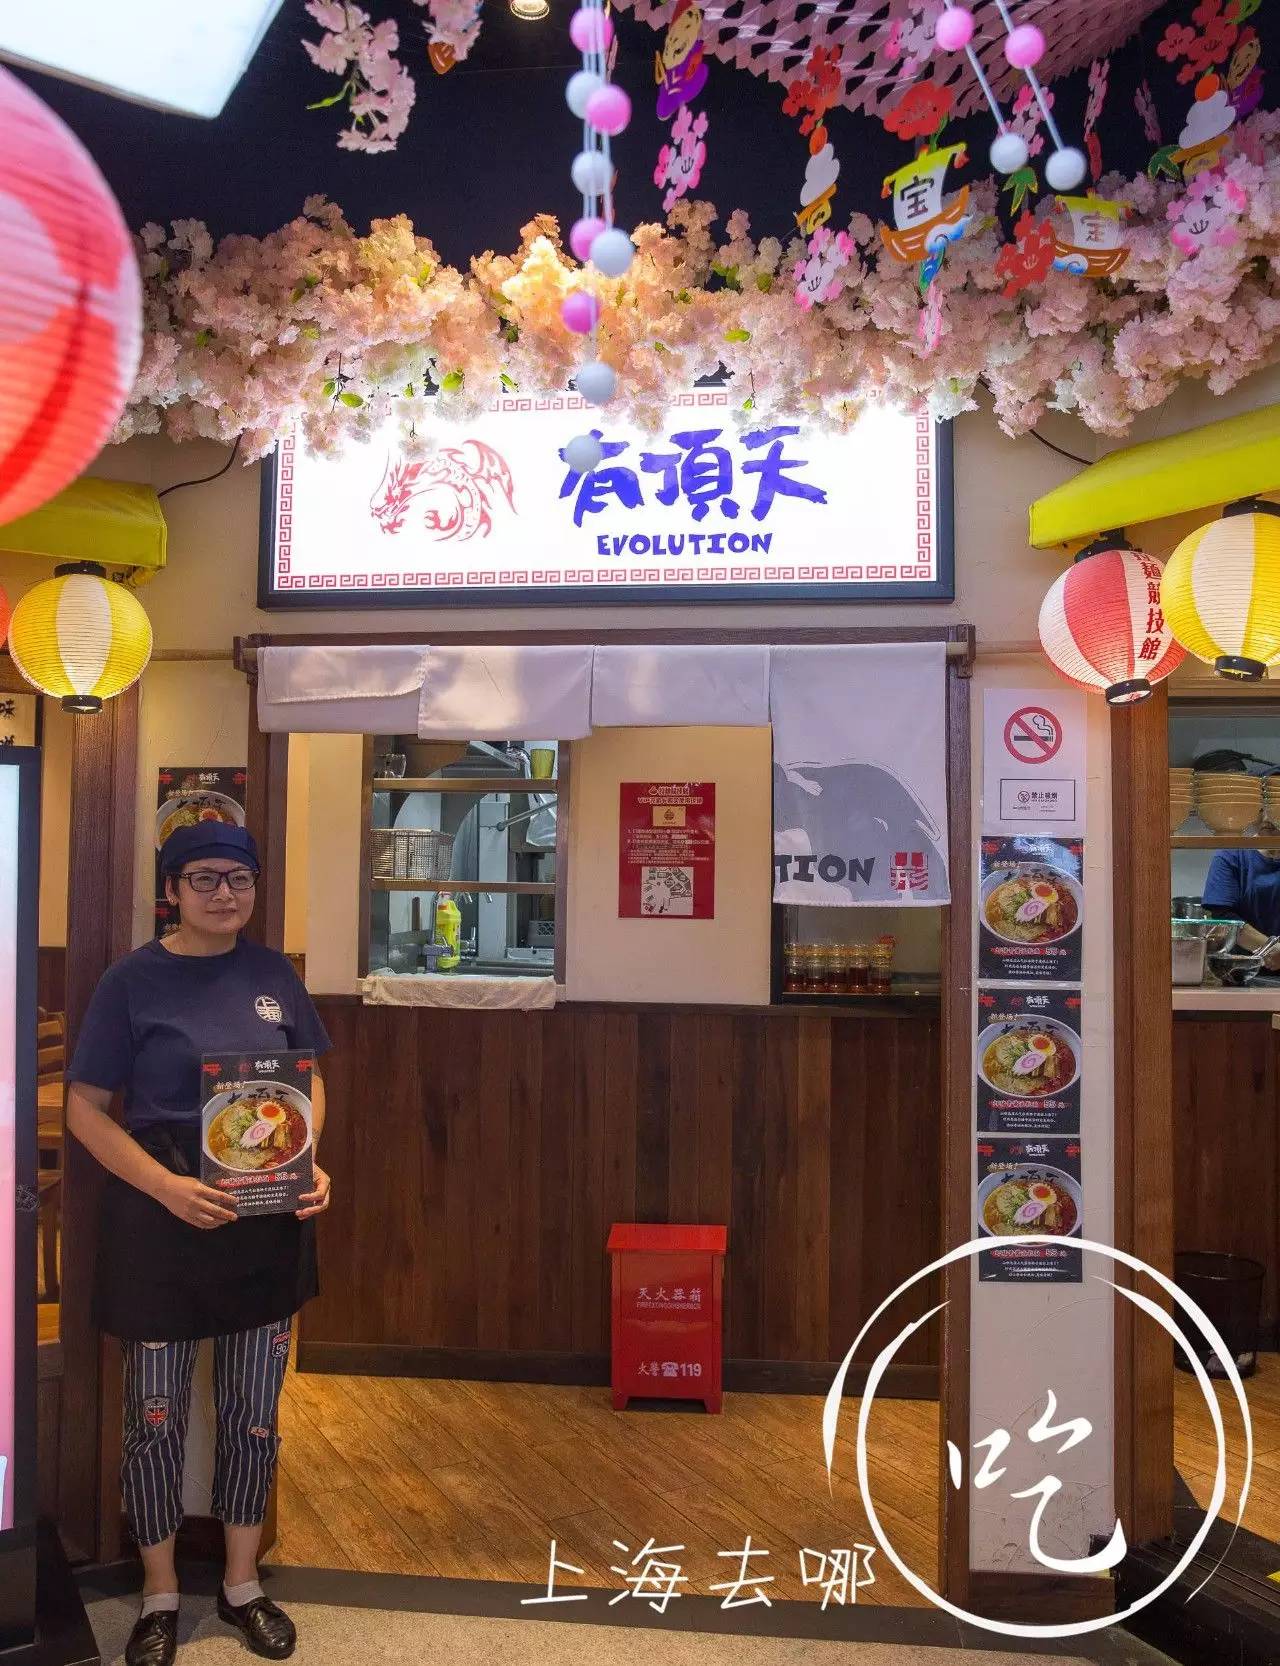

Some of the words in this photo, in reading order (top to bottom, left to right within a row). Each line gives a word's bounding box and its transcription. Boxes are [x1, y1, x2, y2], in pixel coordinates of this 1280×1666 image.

[900, 175, 934, 219] 宝
[597, 532, 773, 556] EVOLUTION
[774, 854, 876, 886] TION
[680, 1362, 702, 1377] 119
